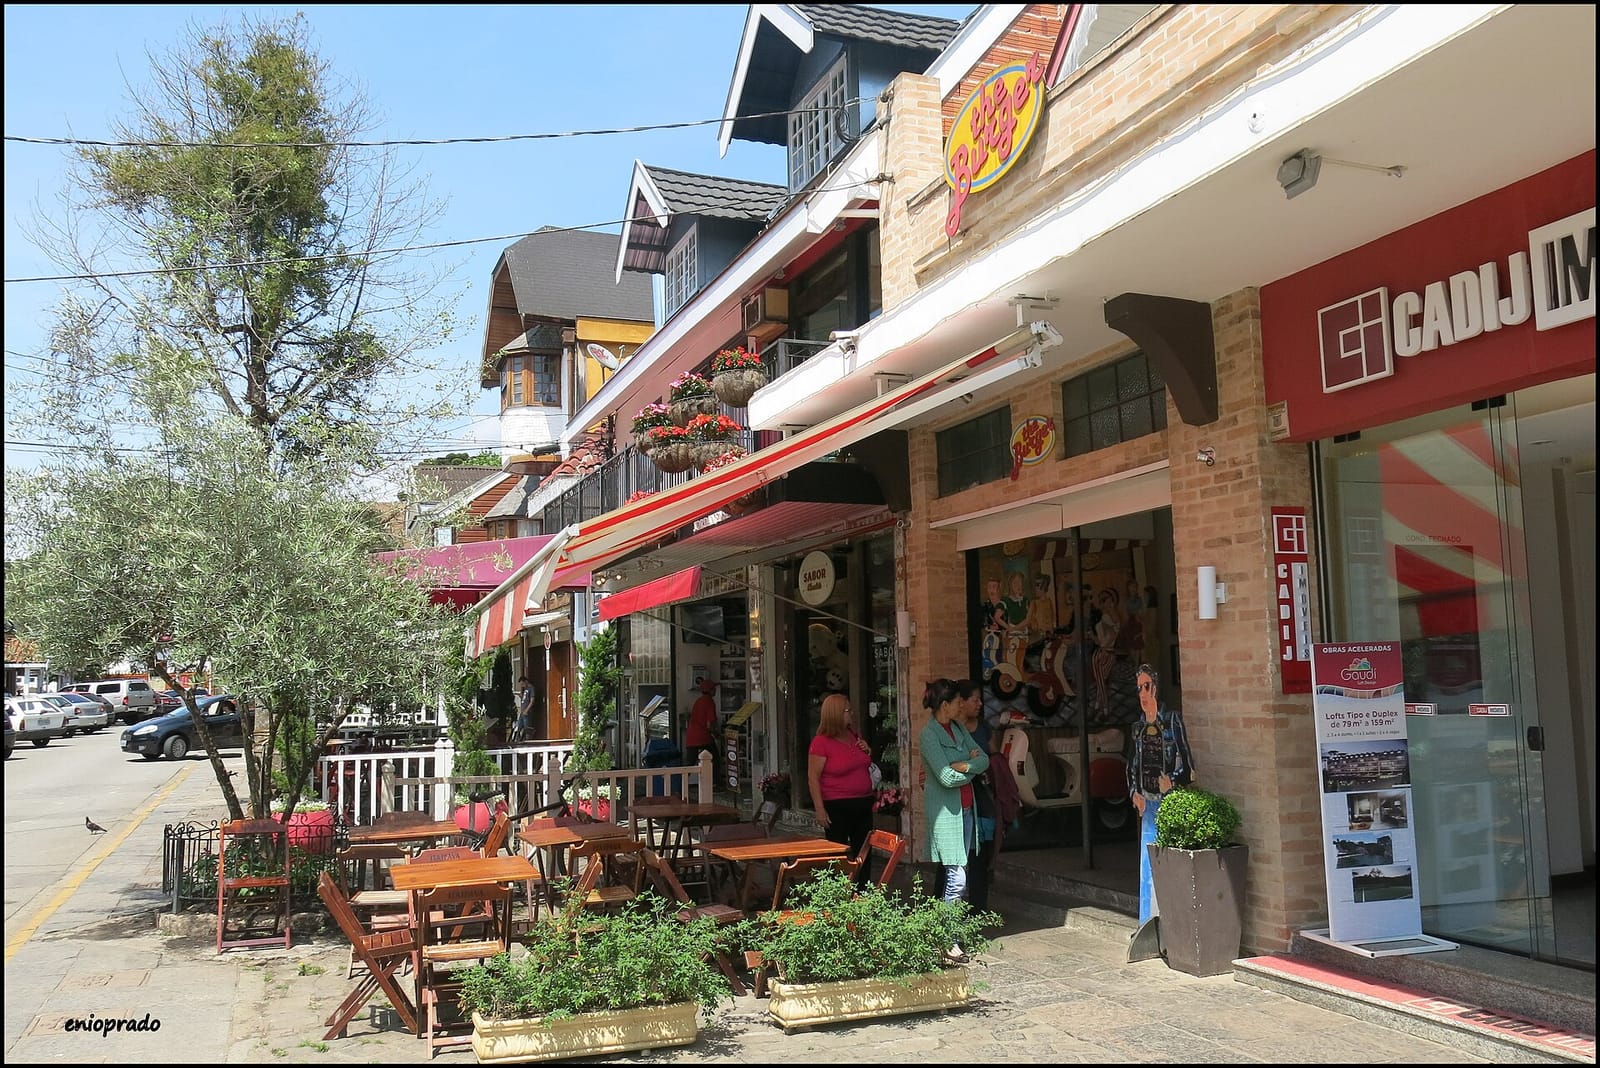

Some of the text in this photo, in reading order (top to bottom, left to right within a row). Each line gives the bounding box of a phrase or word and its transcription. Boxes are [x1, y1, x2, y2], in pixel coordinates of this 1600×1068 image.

[970, 77, 1008, 141] the
[945, 50, 1045, 238] Burger
[1392, 251, 1532, 357] CADIJ
[1010, 417, 1054, 481] Burger
[1022, 419, 1040, 441] the
[803, 568, 827, 583] SABOR
[1277, 563, 1293, 661] CADIJ
[1322, 645, 1392, 654] OBRAS ACELERADAS
[1325, 712, 1345, 720] Lofts
[1347, 711, 1364, 720] Tipo
[1372, 710, 1399, 719] Duplex
[1330, 721, 1341, 729] de
